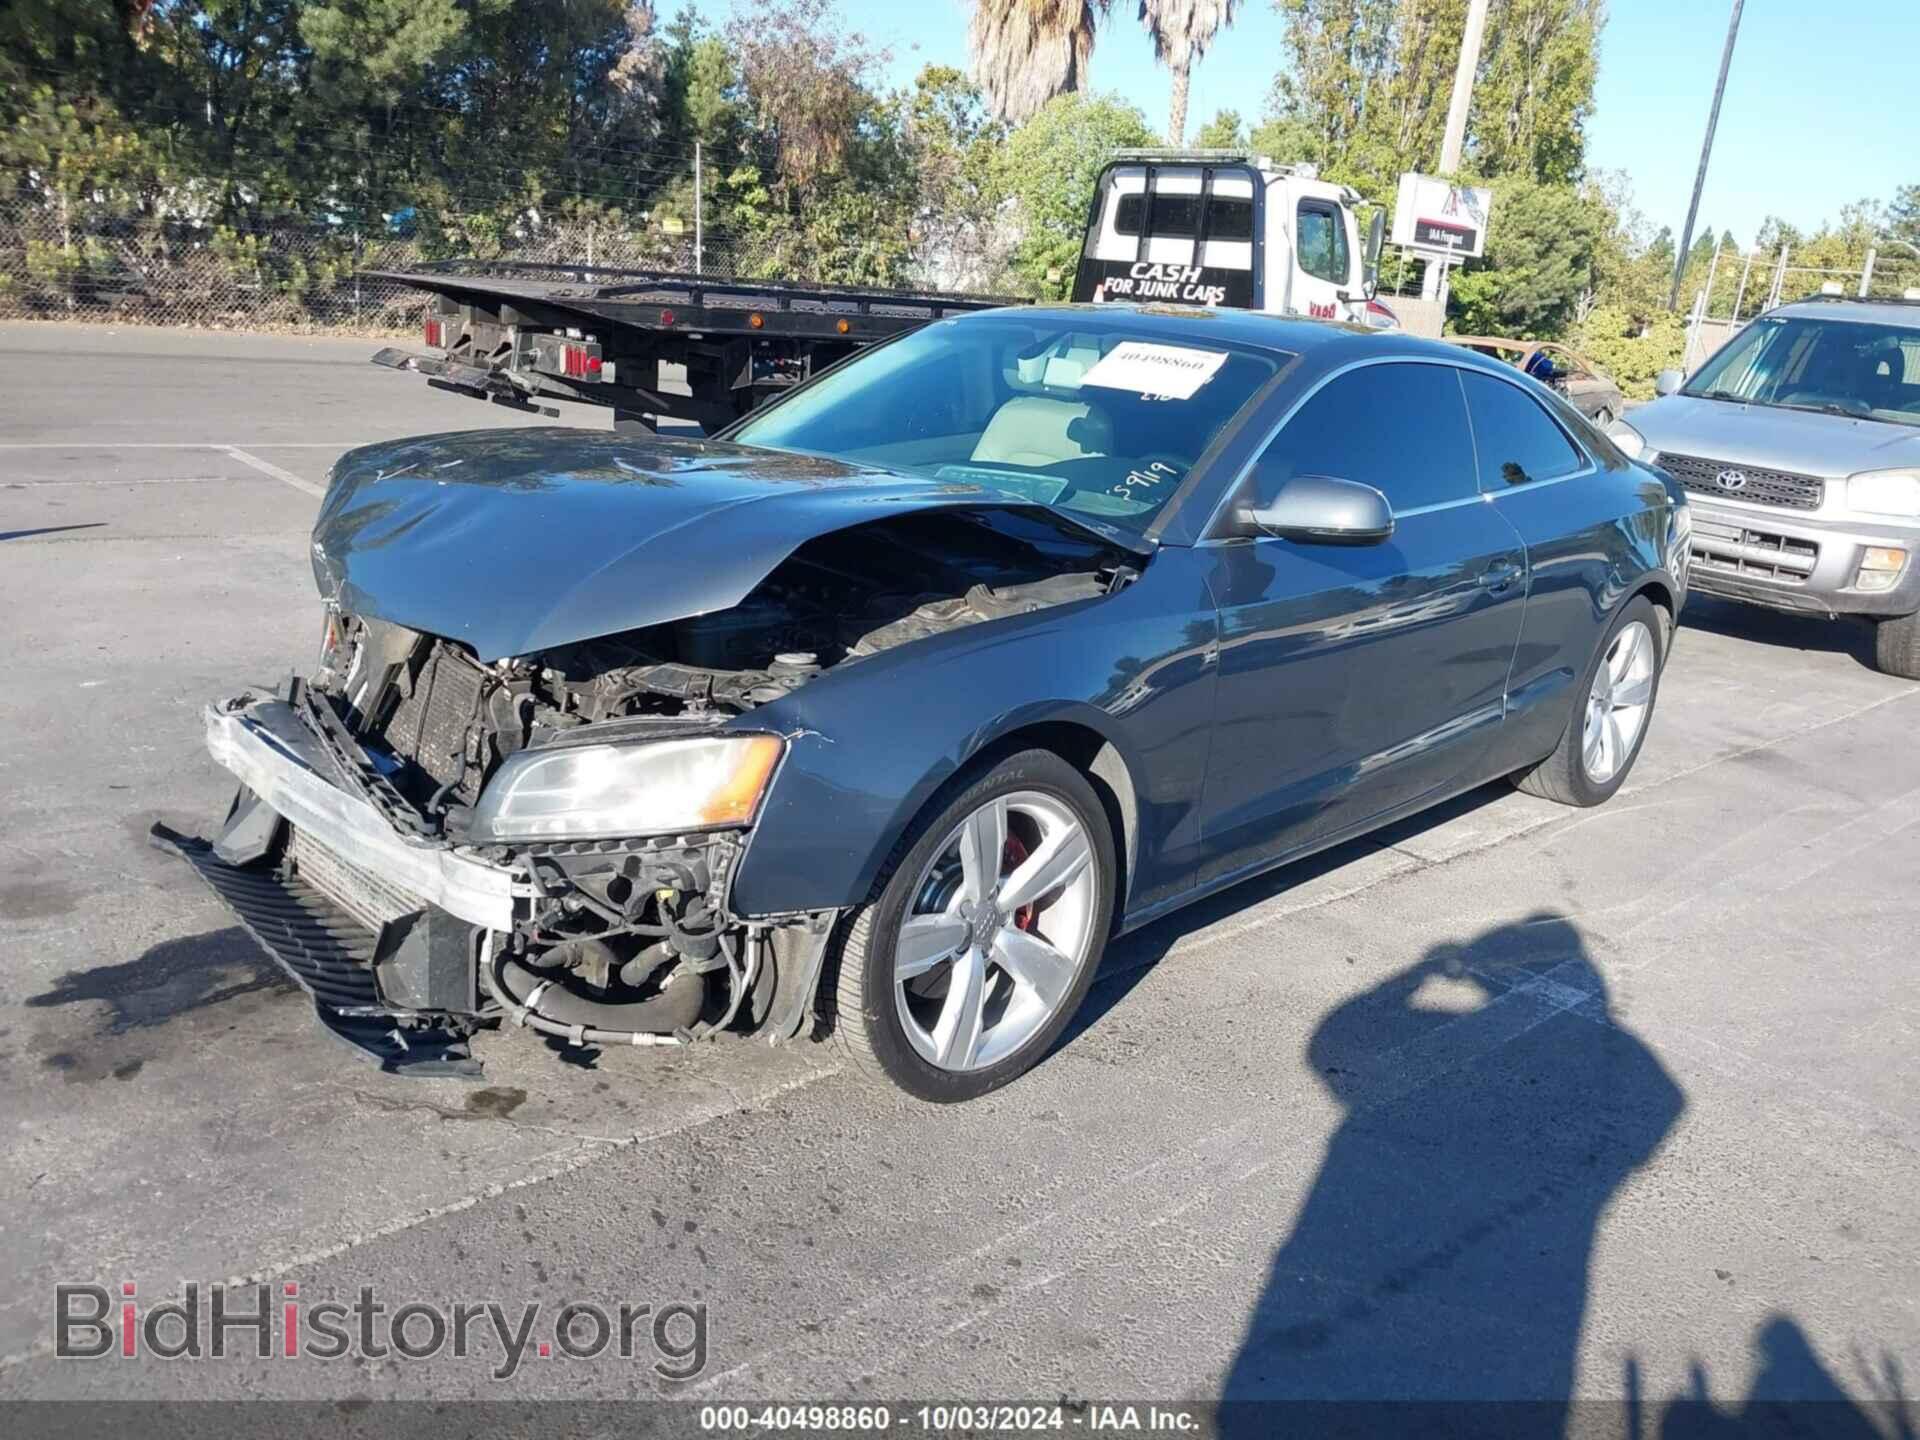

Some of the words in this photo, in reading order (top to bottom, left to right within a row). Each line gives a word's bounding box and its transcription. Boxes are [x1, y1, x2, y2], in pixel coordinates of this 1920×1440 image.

[1130, 262, 1203, 283] CASH
[1103, 277, 1134, 294] FOR
[1135, 280, 1180, 299] JUNK
[1182, 284, 1226, 302] CARS
